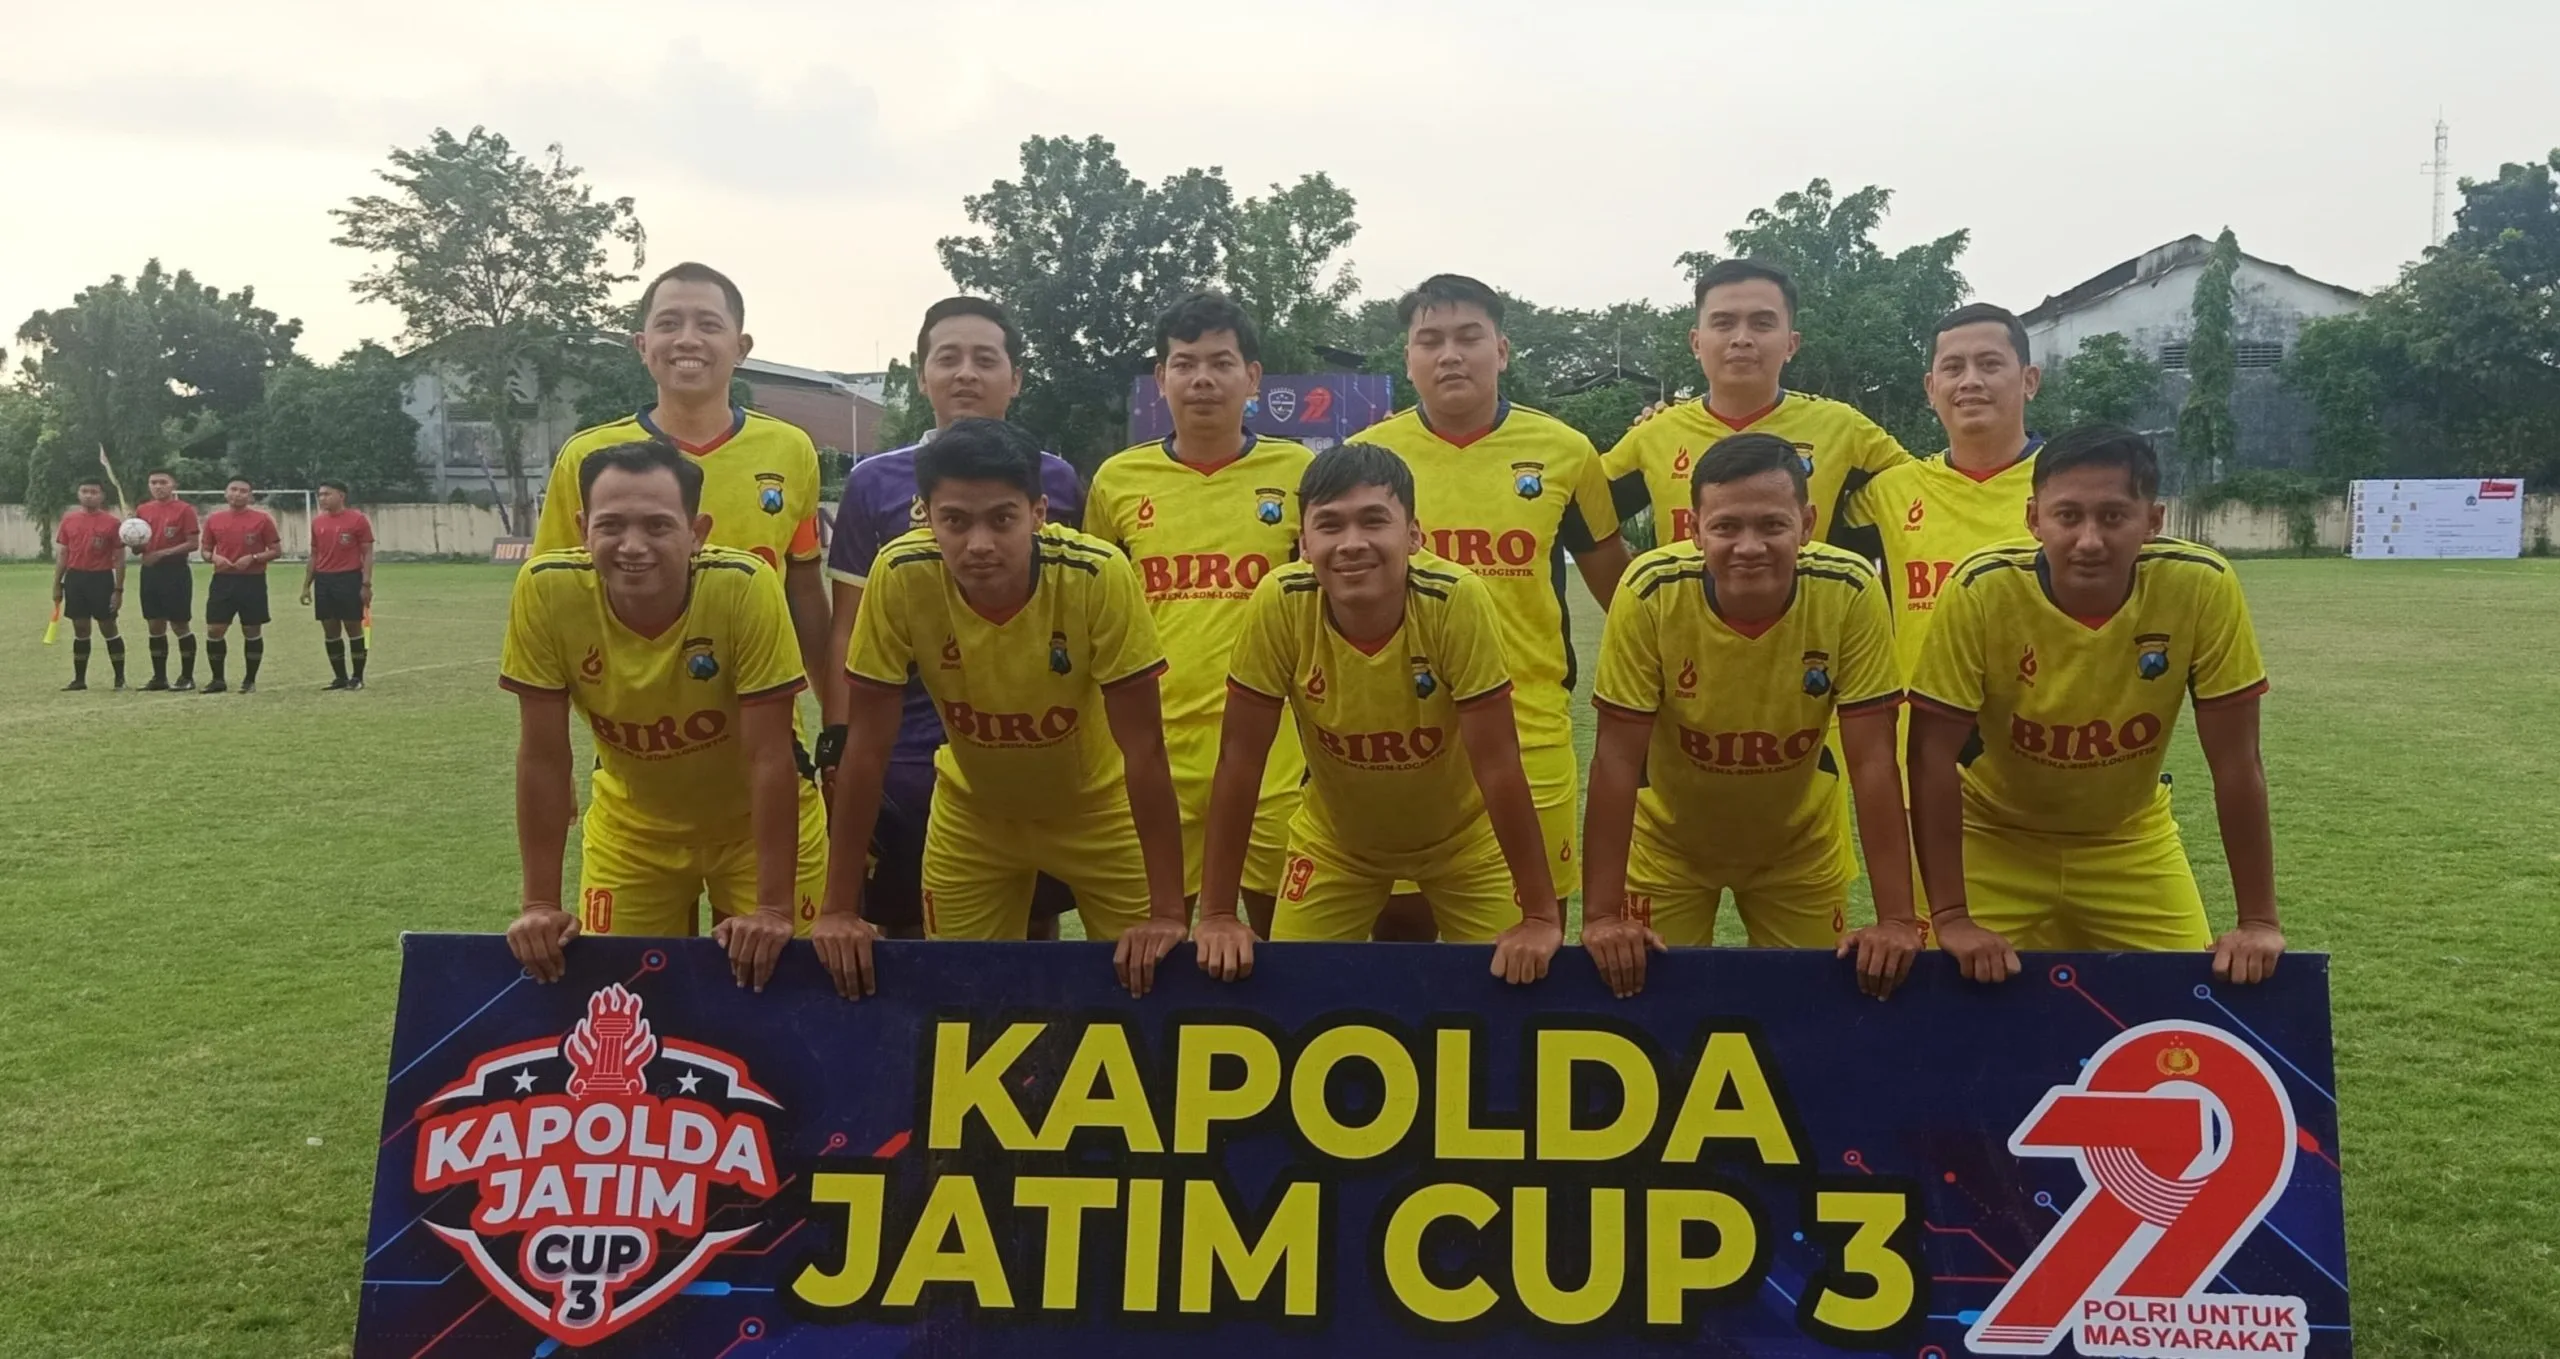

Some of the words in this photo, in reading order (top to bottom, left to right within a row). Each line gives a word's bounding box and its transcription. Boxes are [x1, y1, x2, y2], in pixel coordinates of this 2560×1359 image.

[1139, 553, 1271, 594] BIRO
[587, 707, 728, 753] BIRO
[940, 697, 1079, 743] BIRO
[2011, 711, 2162, 761] BIRO
[1314, 724, 1444, 763] BIRO
[1678, 723, 1821, 767] BIRO
[1280, 856, 1314, 902] 19
[584, 887, 613, 934] 10
[928, 1021, 1799, 1165] KAPOLDA
[425, 1102, 766, 1186] KAPOLDA
[482, 1163, 698, 1227] JATIM
[534, 1233, 643, 1275] CUP
[792, 1172, 1320, 1316] JATIM
[1383, 1183, 1758, 1325] CUP
[1812, 1191, 1915, 1331] 3
[566, 1279, 598, 1321] 3
[2083, 1299, 2177, 1324] POLRI
[2187, 1303, 2297, 1328] UNTUK
[2083, 1324, 2299, 1353] MASYARAKAT
